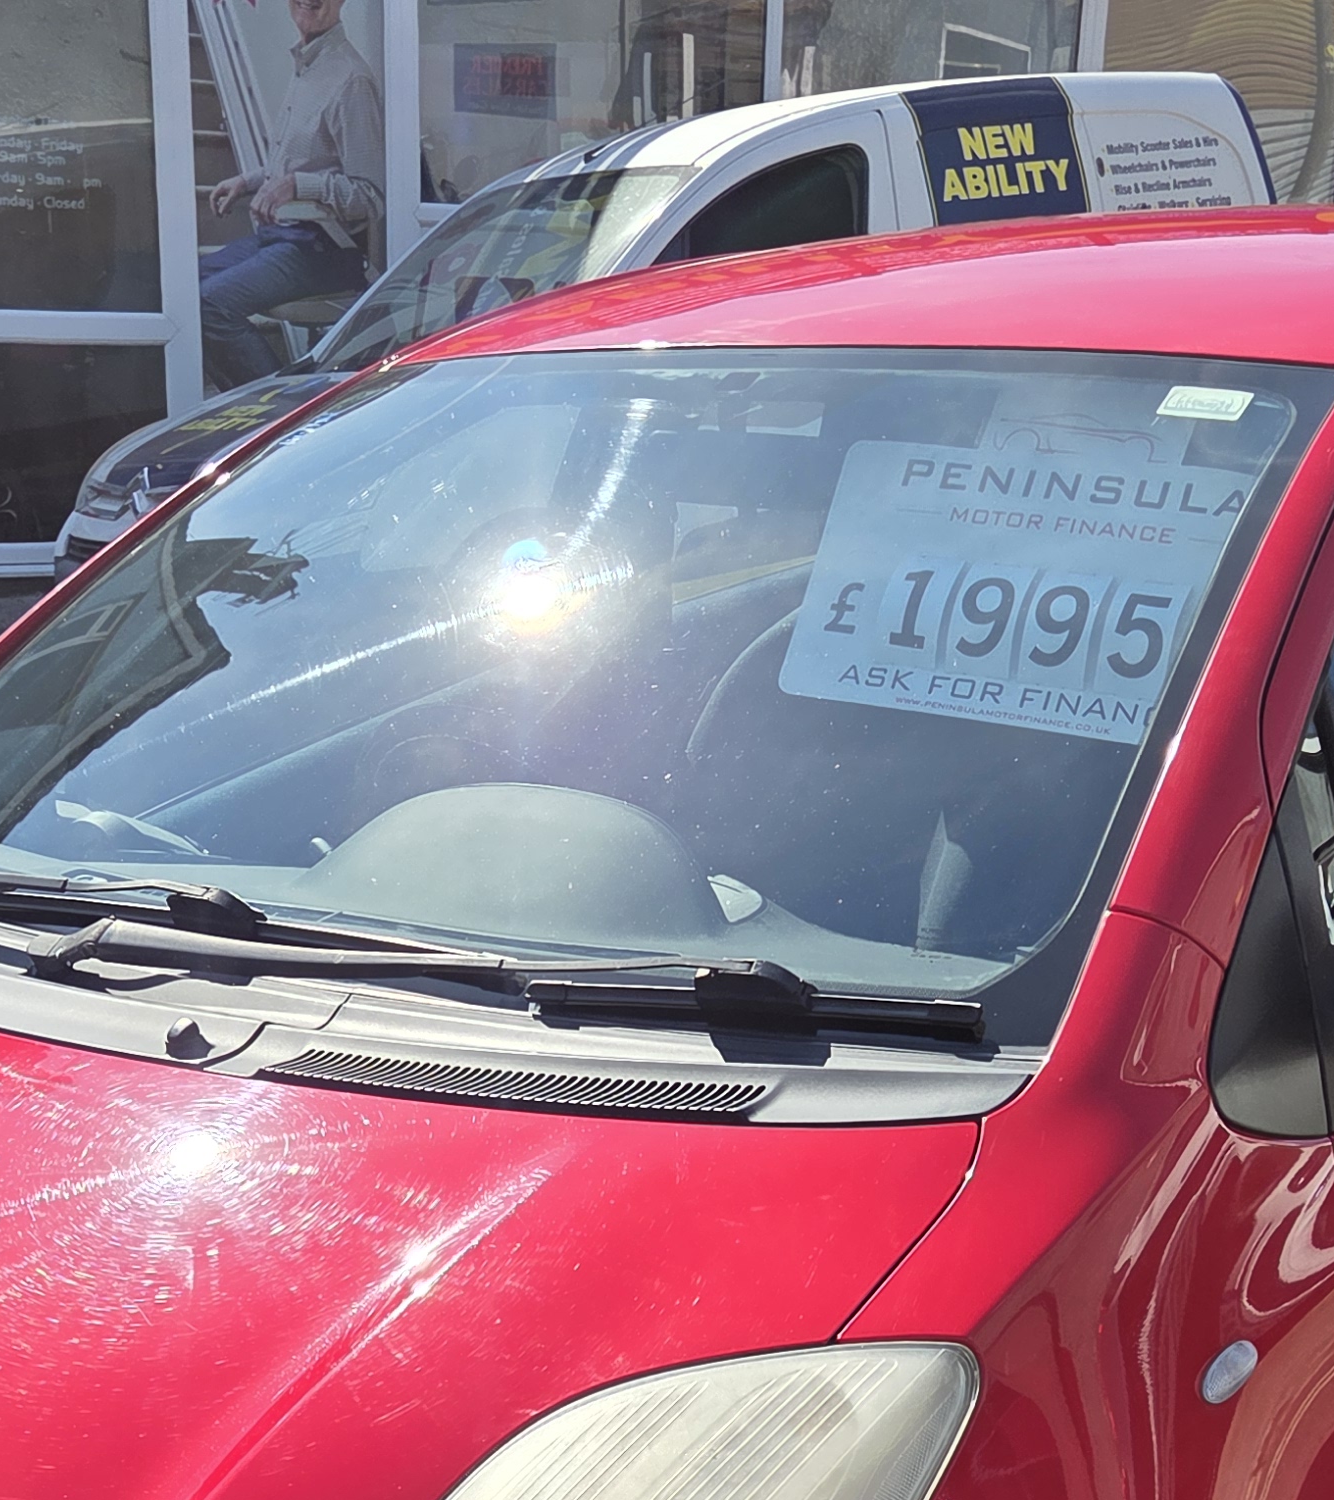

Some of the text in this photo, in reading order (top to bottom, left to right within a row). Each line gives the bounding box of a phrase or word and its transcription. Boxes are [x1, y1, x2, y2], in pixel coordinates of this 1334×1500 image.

[41, 138, 84, 154] Friday
[957, 123, 1035, 161] NEW
[1106, 135, 1219, 156] Mobility Scooter Sales & Hire
[37, 152, 66, 167] 5pm
[1110, 156, 1217, 175] Wheelchairs & Powerchairs
[35, 173, 64, 185] 9am
[943, 159, 1069, 202] ABILITY
[1114, 177, 1213, 195] Rise & Recline Armchairs
[43, 196, 85, 209] Closed
[901, 459, 1247, 517] PENINSULA
[949, 507, 1176, 544] MOTOR FINANCE
[889, 570, 1172, 679] 1995
[838, 664, 1155, 728] ASK FOR FINAN
